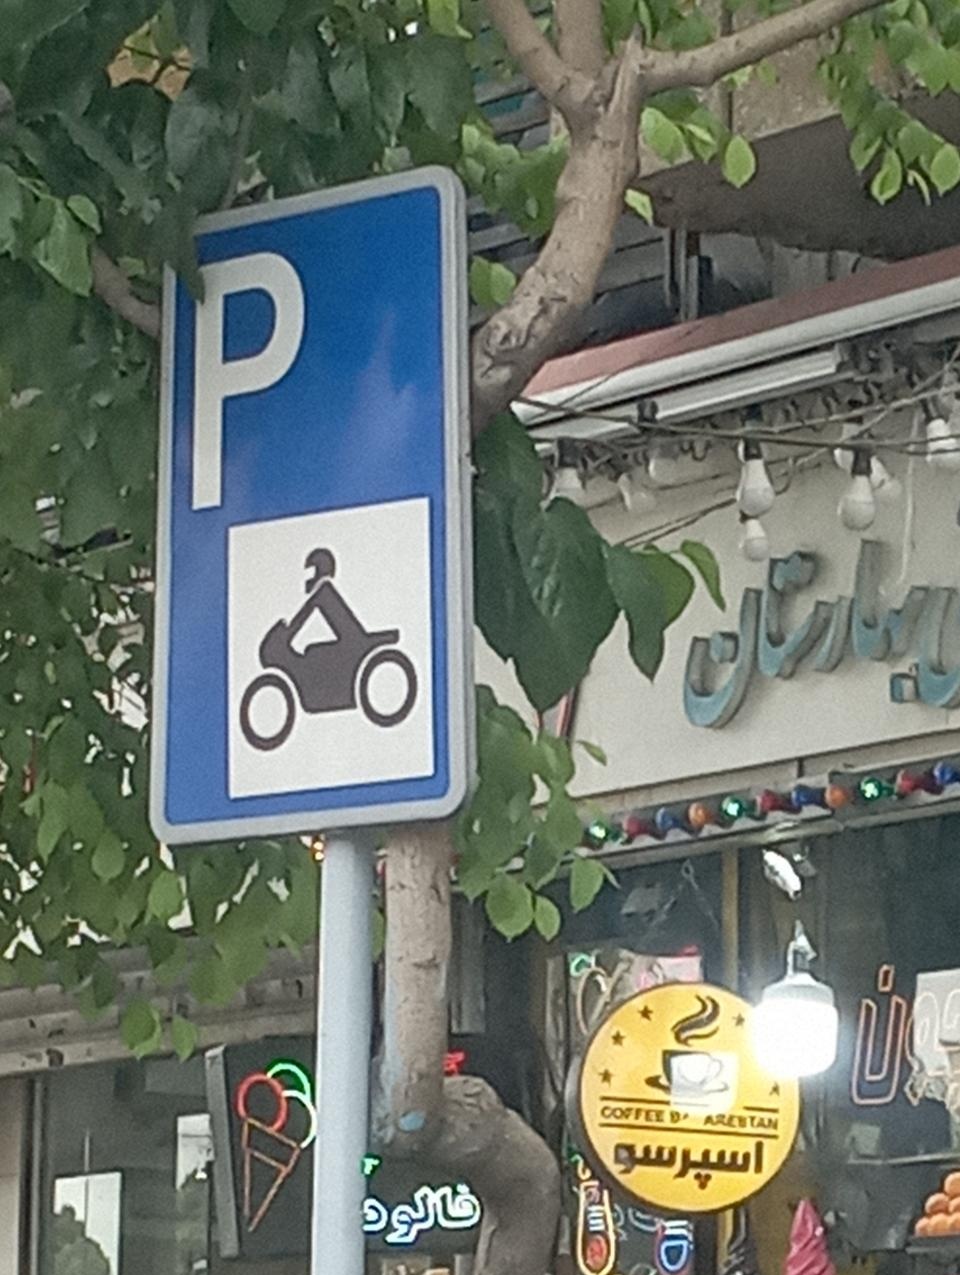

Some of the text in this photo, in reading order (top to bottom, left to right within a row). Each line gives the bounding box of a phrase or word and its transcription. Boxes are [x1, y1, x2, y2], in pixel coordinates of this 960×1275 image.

[193, 251, 305, 511] P
[600, 1105, 665, 1124] COFFEE
[613, 1140, 764, 1190] اسپرسو
[361, 1182, 482, 1244] فالود
